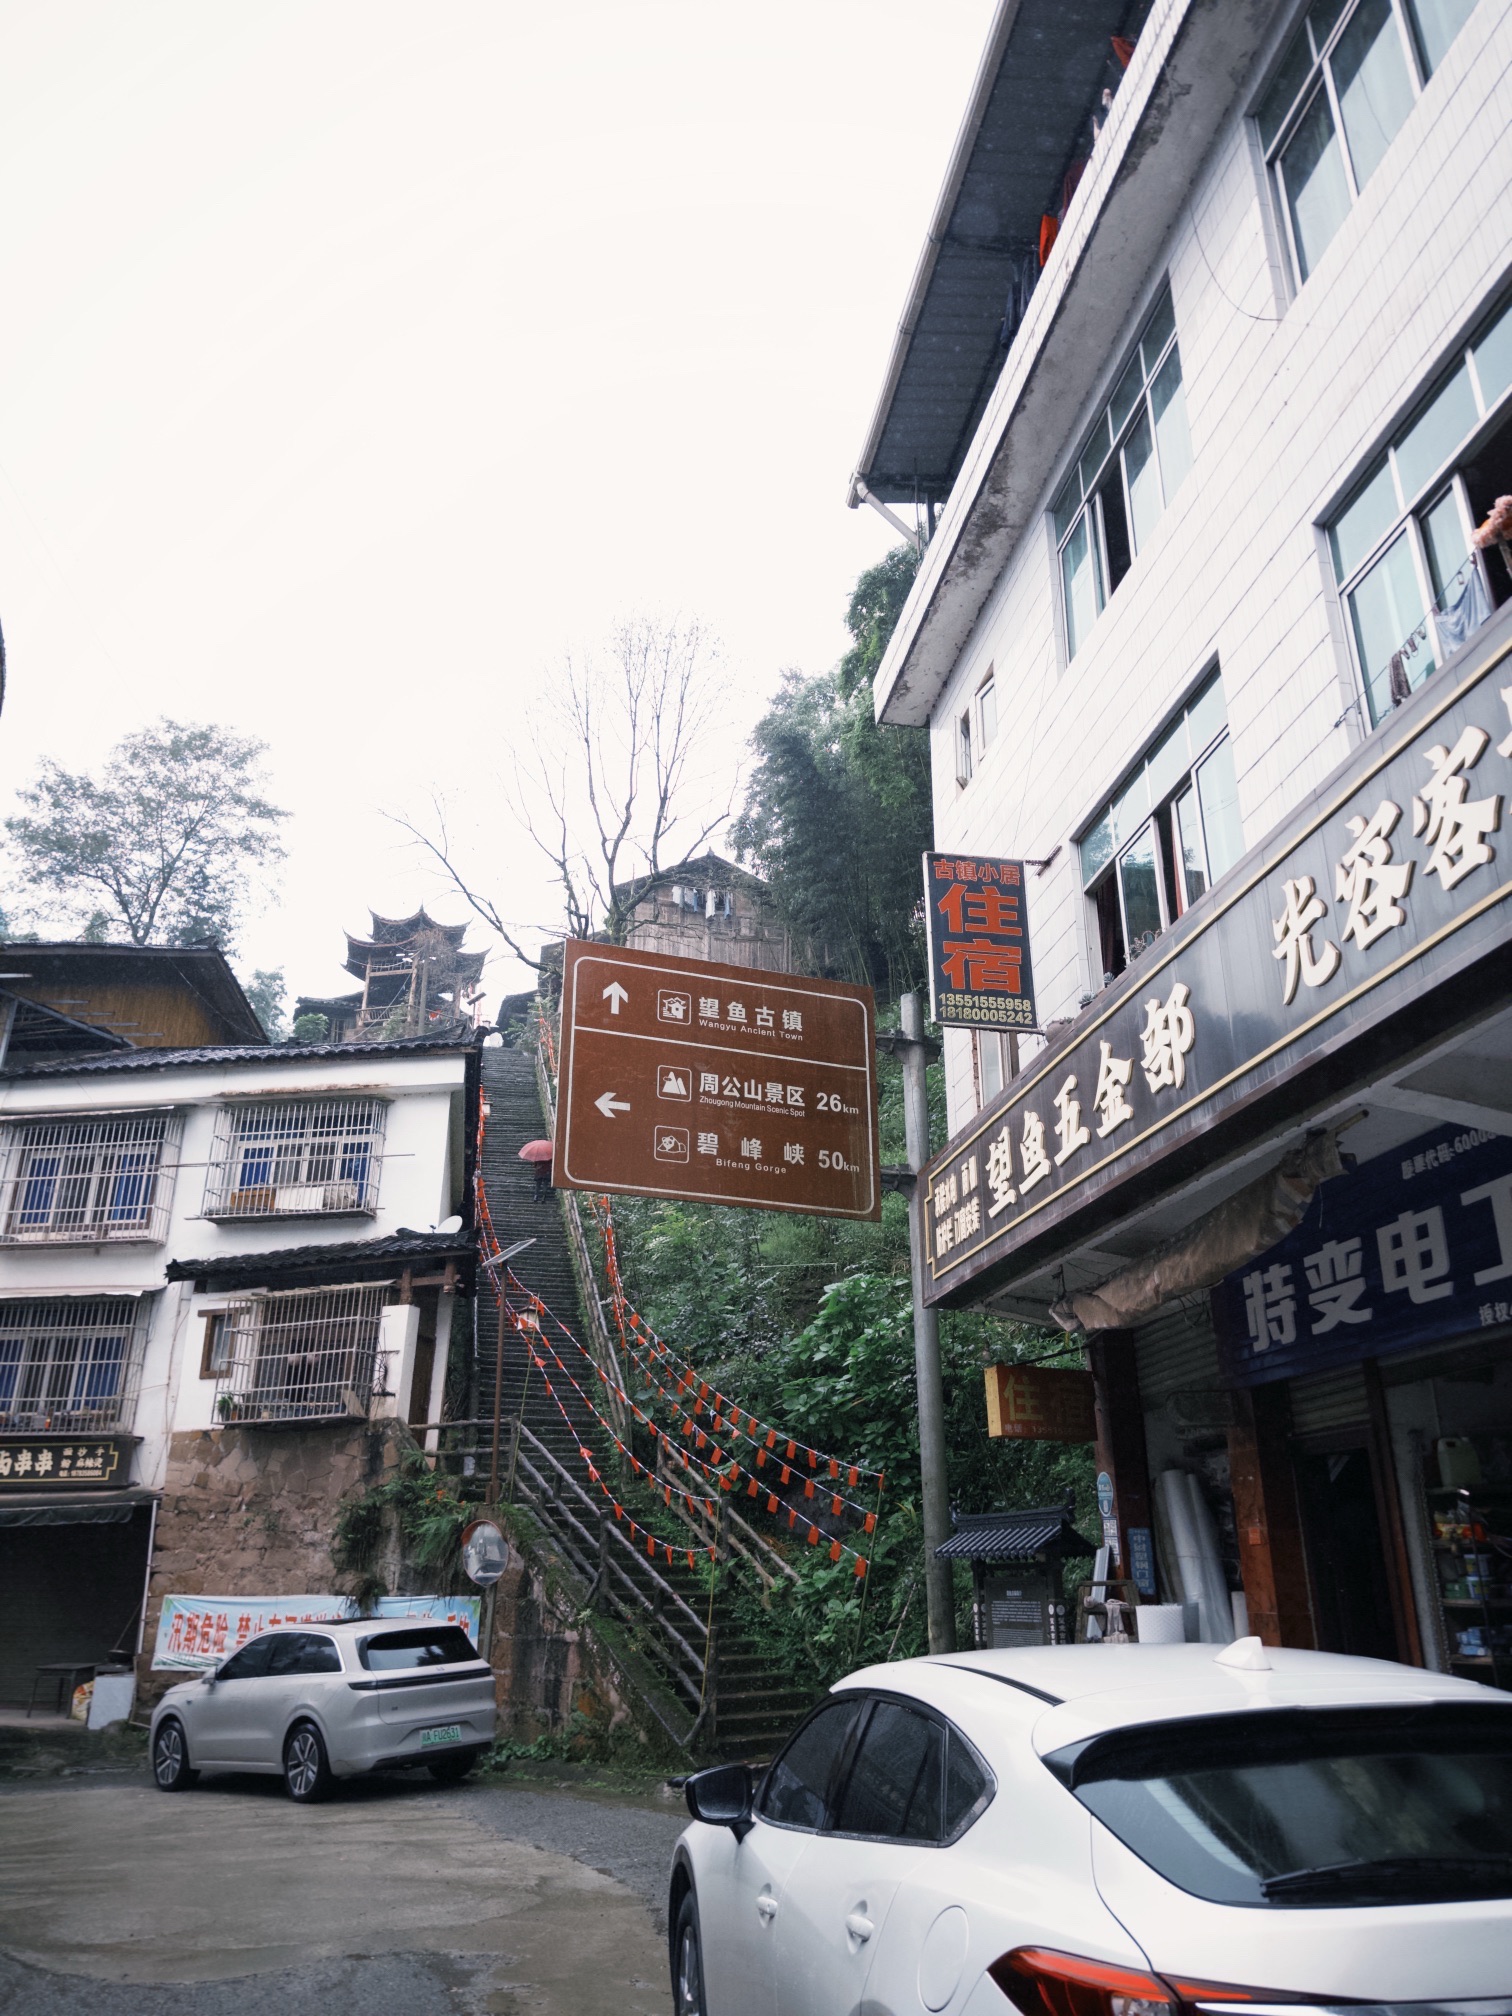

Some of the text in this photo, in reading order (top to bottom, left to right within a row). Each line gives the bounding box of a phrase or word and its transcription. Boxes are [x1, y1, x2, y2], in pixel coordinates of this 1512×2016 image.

[933, 858, 1021, 886] 古镇小居
[937, 882, 1022, 994] 住宿
[698, 996, 803, 1031] 望鱼古镇
[938, 993, 1031, 1012] 13551555958
[939, 1006, 1032, 1024] 18180005242
[699, 1018, 803, 1041] Wangyu Ancient Town
[699, 1072, 806, 1107] 周公山景区
[985, 982, 1195, 1218] 望鱼五金部
[699, 1096, 806, 1117] Zhougong Mountain Scenic Spot
[697, 1132, 805, 1166] 碧峰峡
[716, 1158, 787, 1174] Bifeng Gorge
[167, 1612, 229, 1654] 汛期危险
